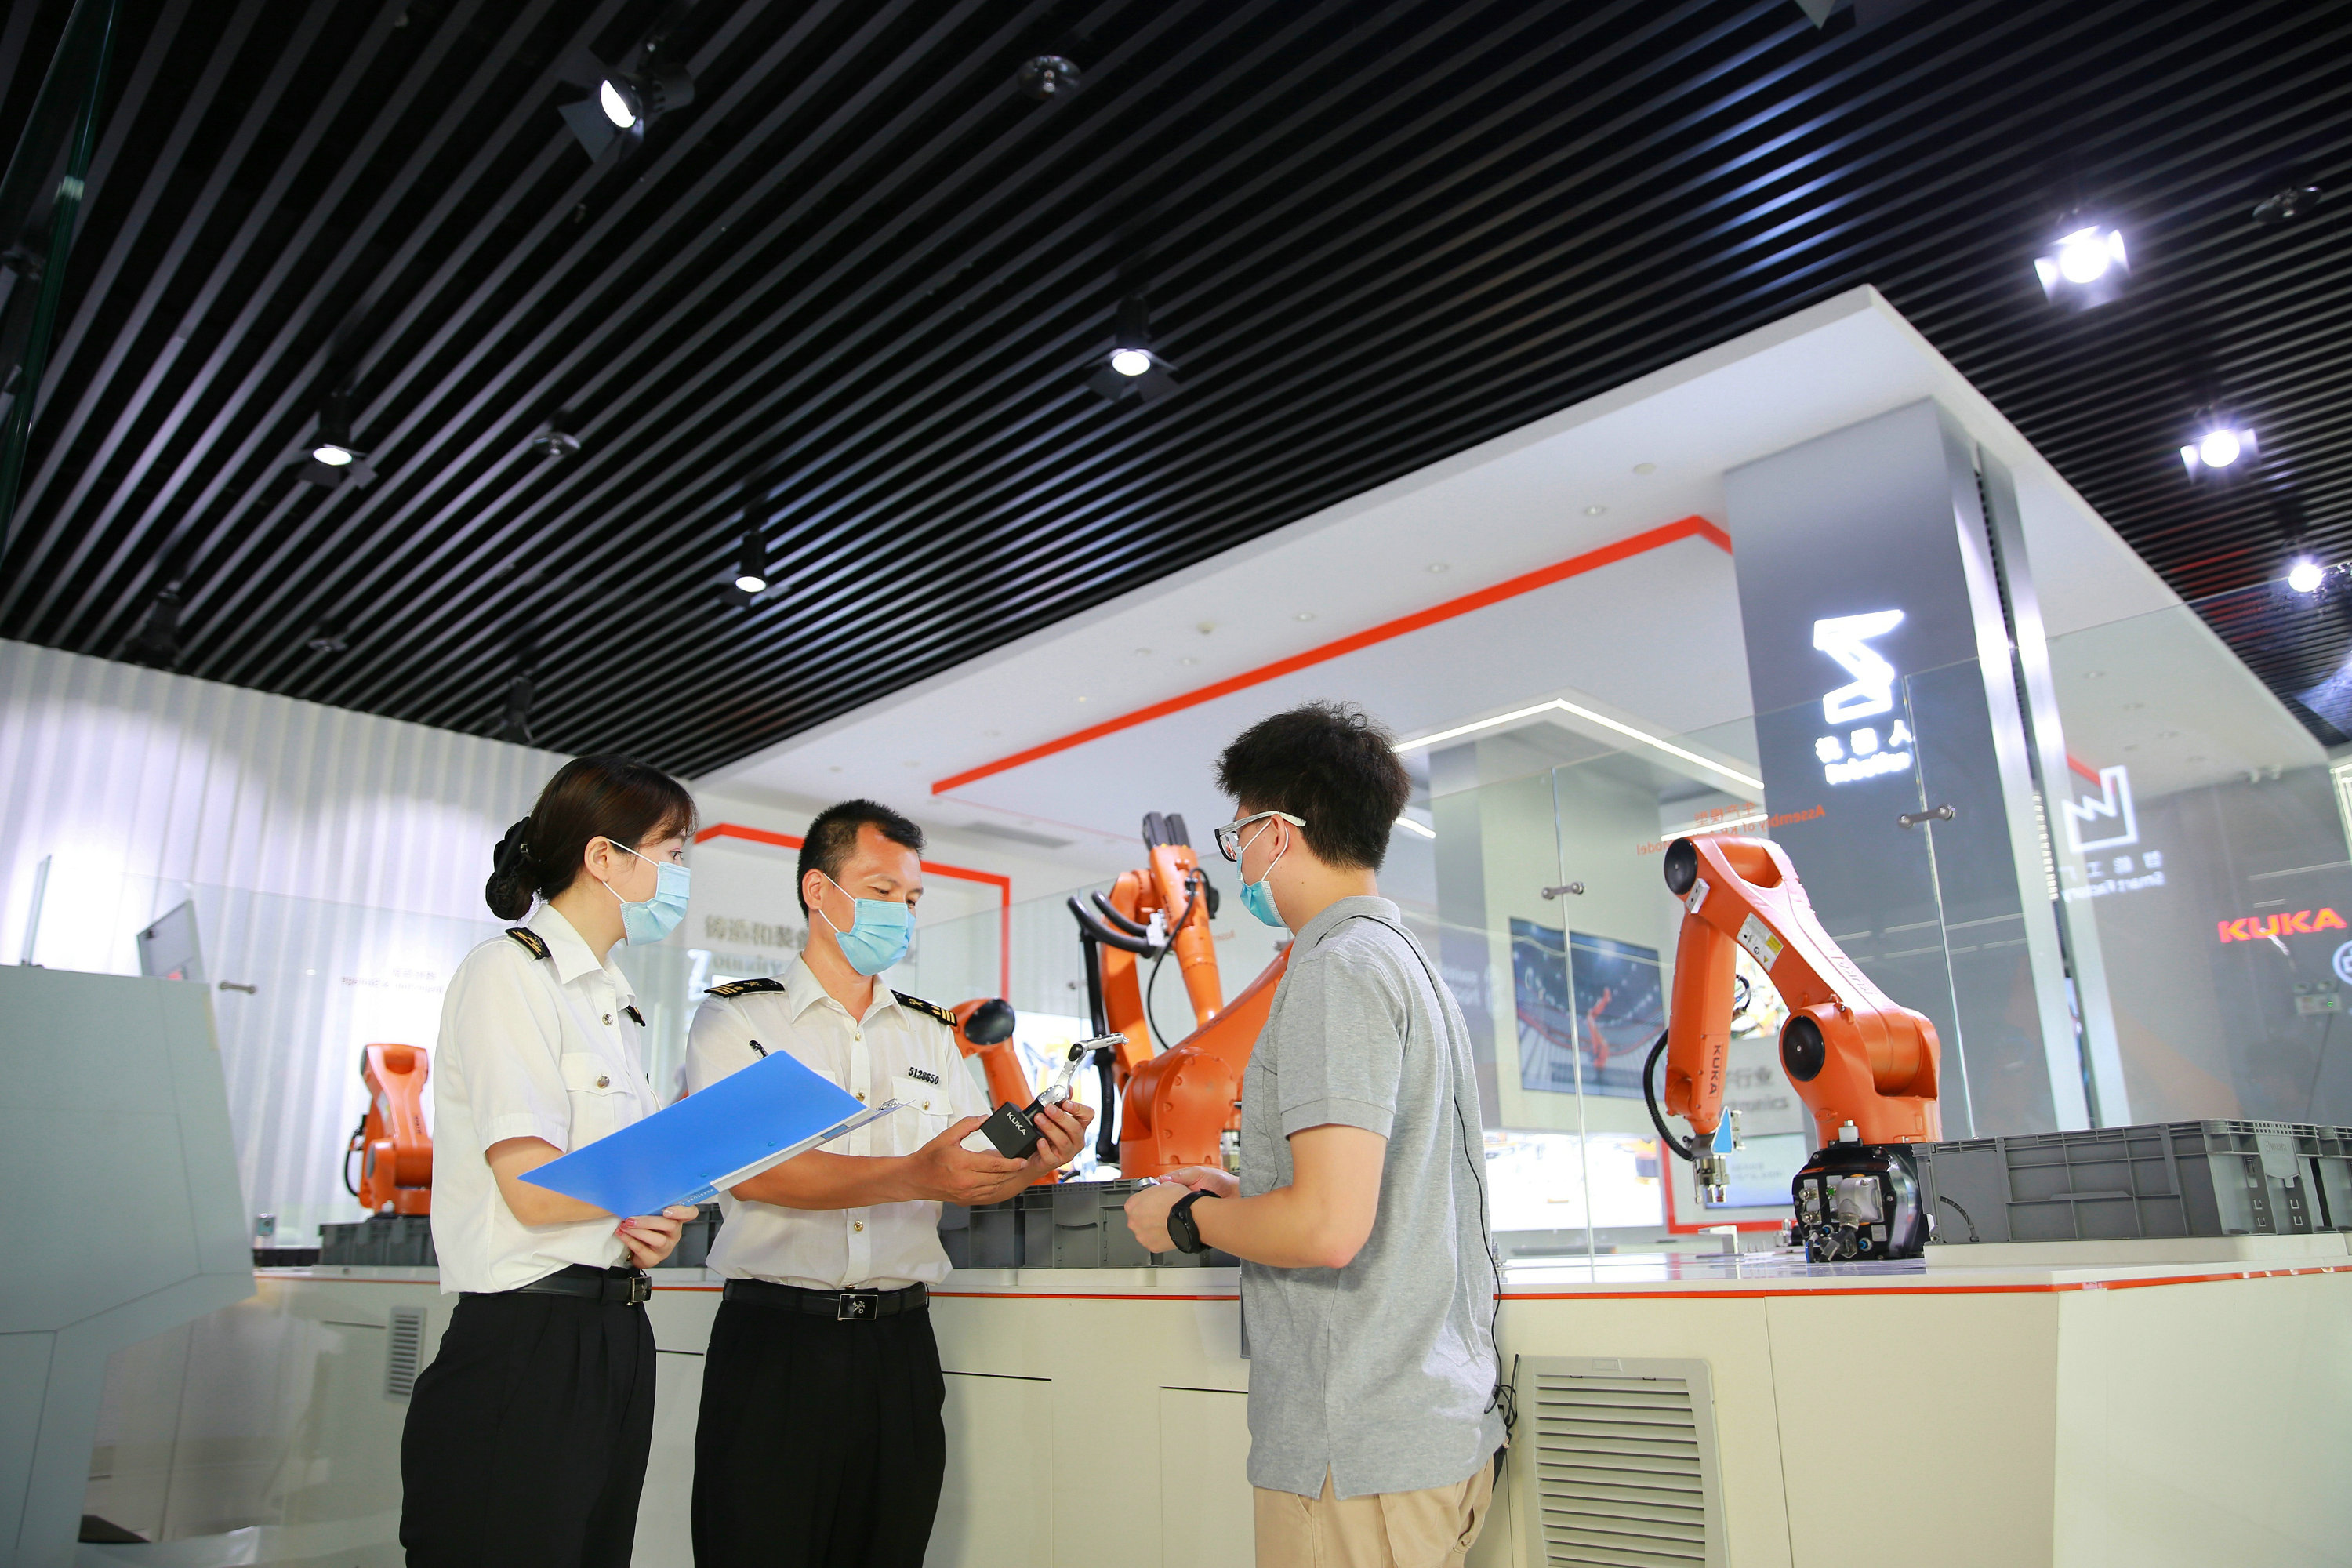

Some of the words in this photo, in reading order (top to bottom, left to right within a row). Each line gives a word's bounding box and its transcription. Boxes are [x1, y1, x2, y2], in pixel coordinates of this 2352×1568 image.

[2218, 908, 2347, 943] KUKA
[908, 1066, 940, 1086] 5128650
[1709, 1044, 1722, 1095] KUKA
[1006, 1112, 1027, 1136] KUKA
